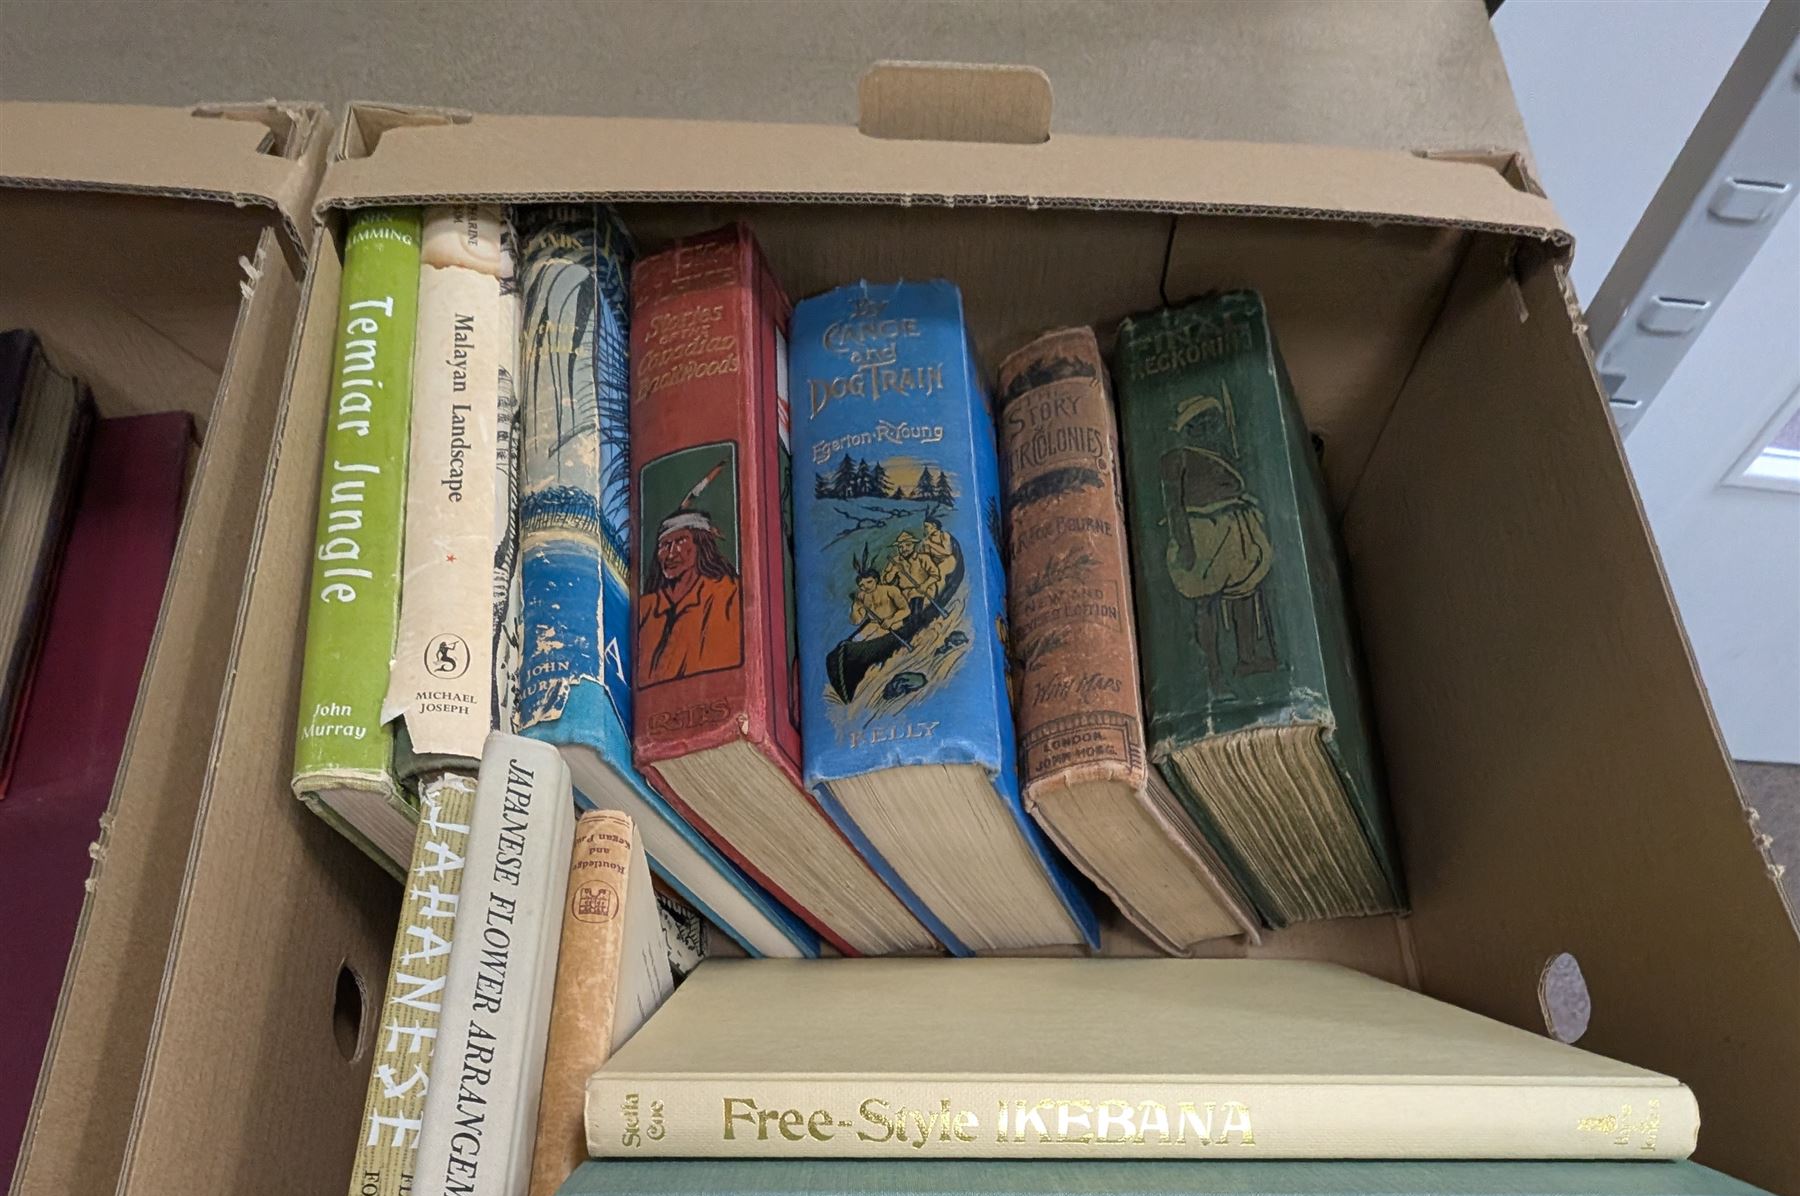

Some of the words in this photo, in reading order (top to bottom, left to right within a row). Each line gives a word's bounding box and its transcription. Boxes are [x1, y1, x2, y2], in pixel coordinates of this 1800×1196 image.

[337, 296, 394, 437] Temiar
[446, 312, 475, 392] Malayan
[441, 404, 472, 503] Landscape
[318, 460, 381, 604] Jungle
[314, 702, 352, 718] John
[416, 691, 478, 705] MICHAEL
[419, 702, 470, 715] JOSEPH
[302, 721, 367, 741] Murray
[851, 721, 940, 749] KELLY
[493, 758, 535, 886] JAPANESE
[598, 834, 631, 850] Kegan
[588, 847, 610, 856] and
[469, 891, 517, 1015] FLOWER
[721, 1096, 979, 1150] Free-Style
[996, 1097, 1257, 1148] IKEBANA
